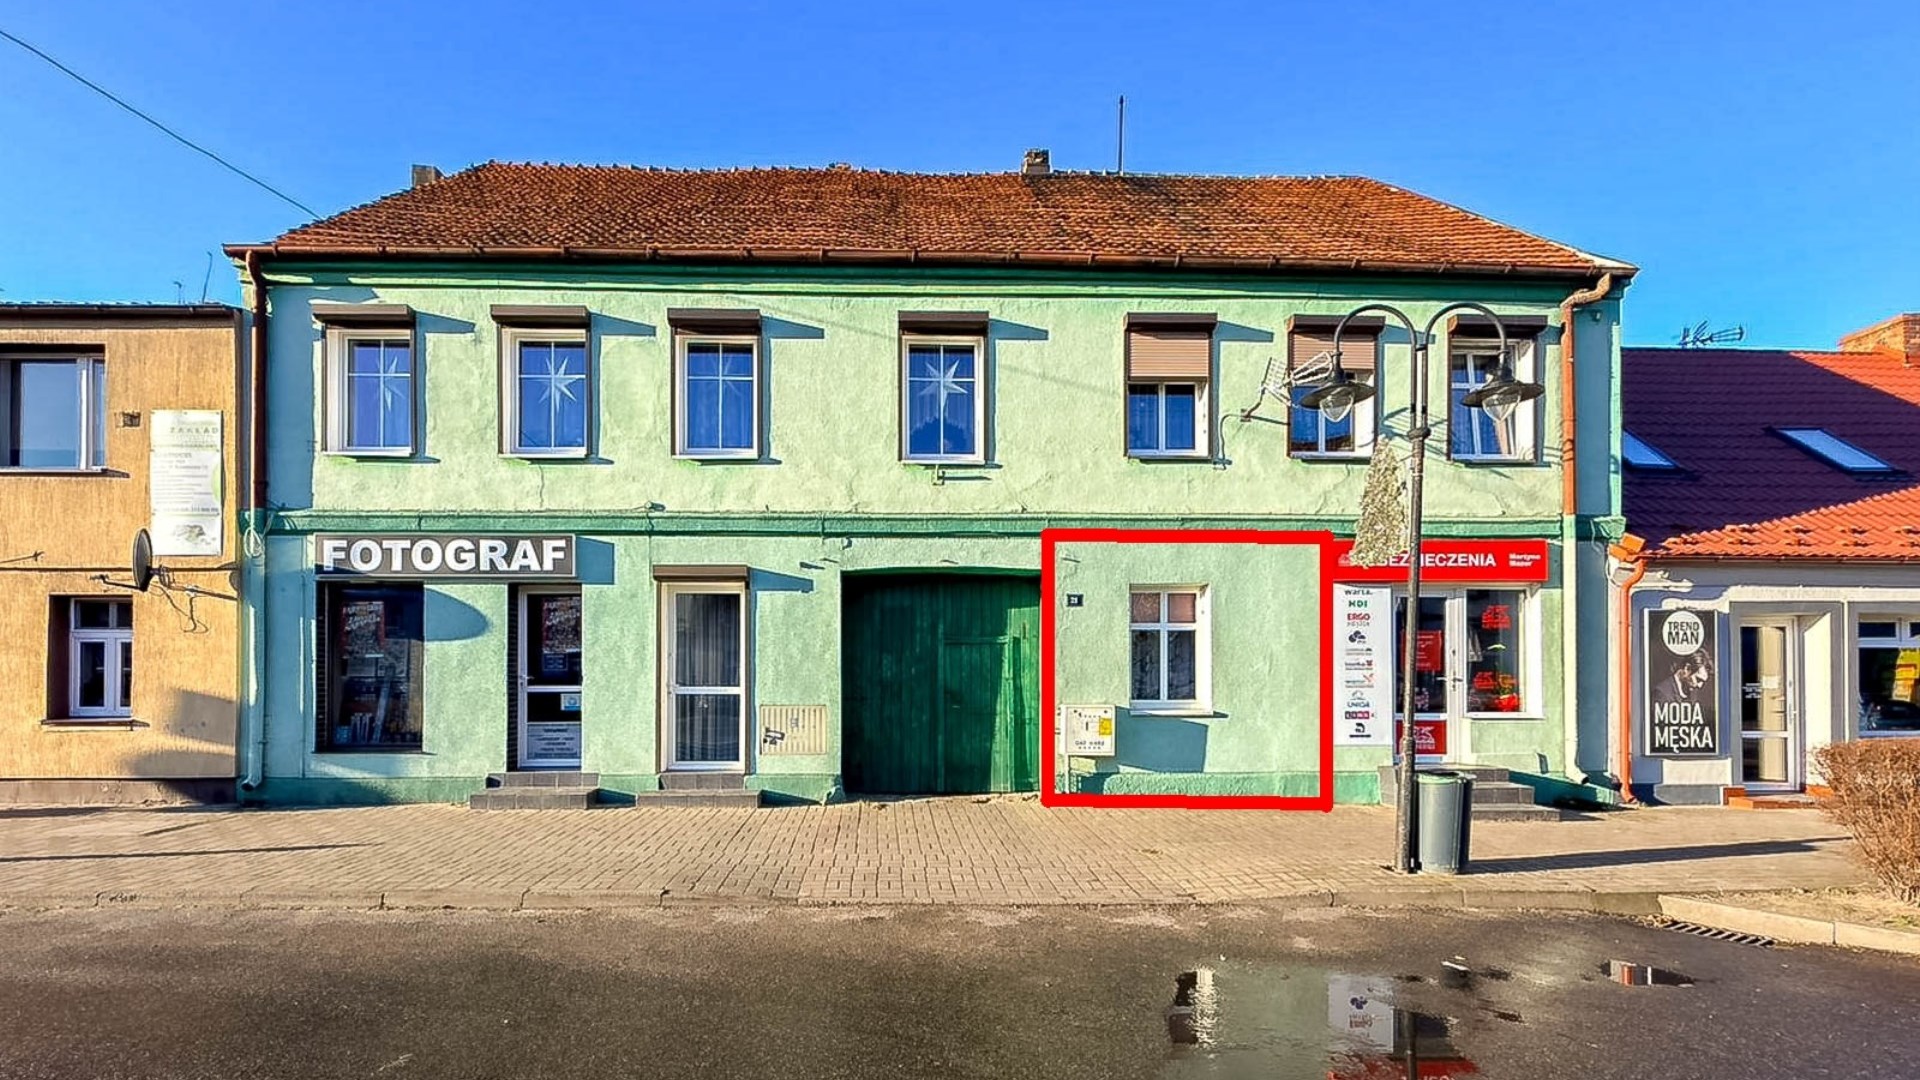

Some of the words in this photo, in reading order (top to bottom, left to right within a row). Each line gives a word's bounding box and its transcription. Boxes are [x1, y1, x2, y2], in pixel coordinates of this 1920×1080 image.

[322, 538, 566, 572] FOTOGRAF
[1363, 553, 1496, 567] BEZIECZENIA
[1347, 613, 1371, 621] ERGO
[1667, 621, 1700, 632] TREND
[1667, 632, 1700, 645] MAN
[1654, 702, 1704, 725] MODA
[1654, 725, 1713, 753] MĘSKA
